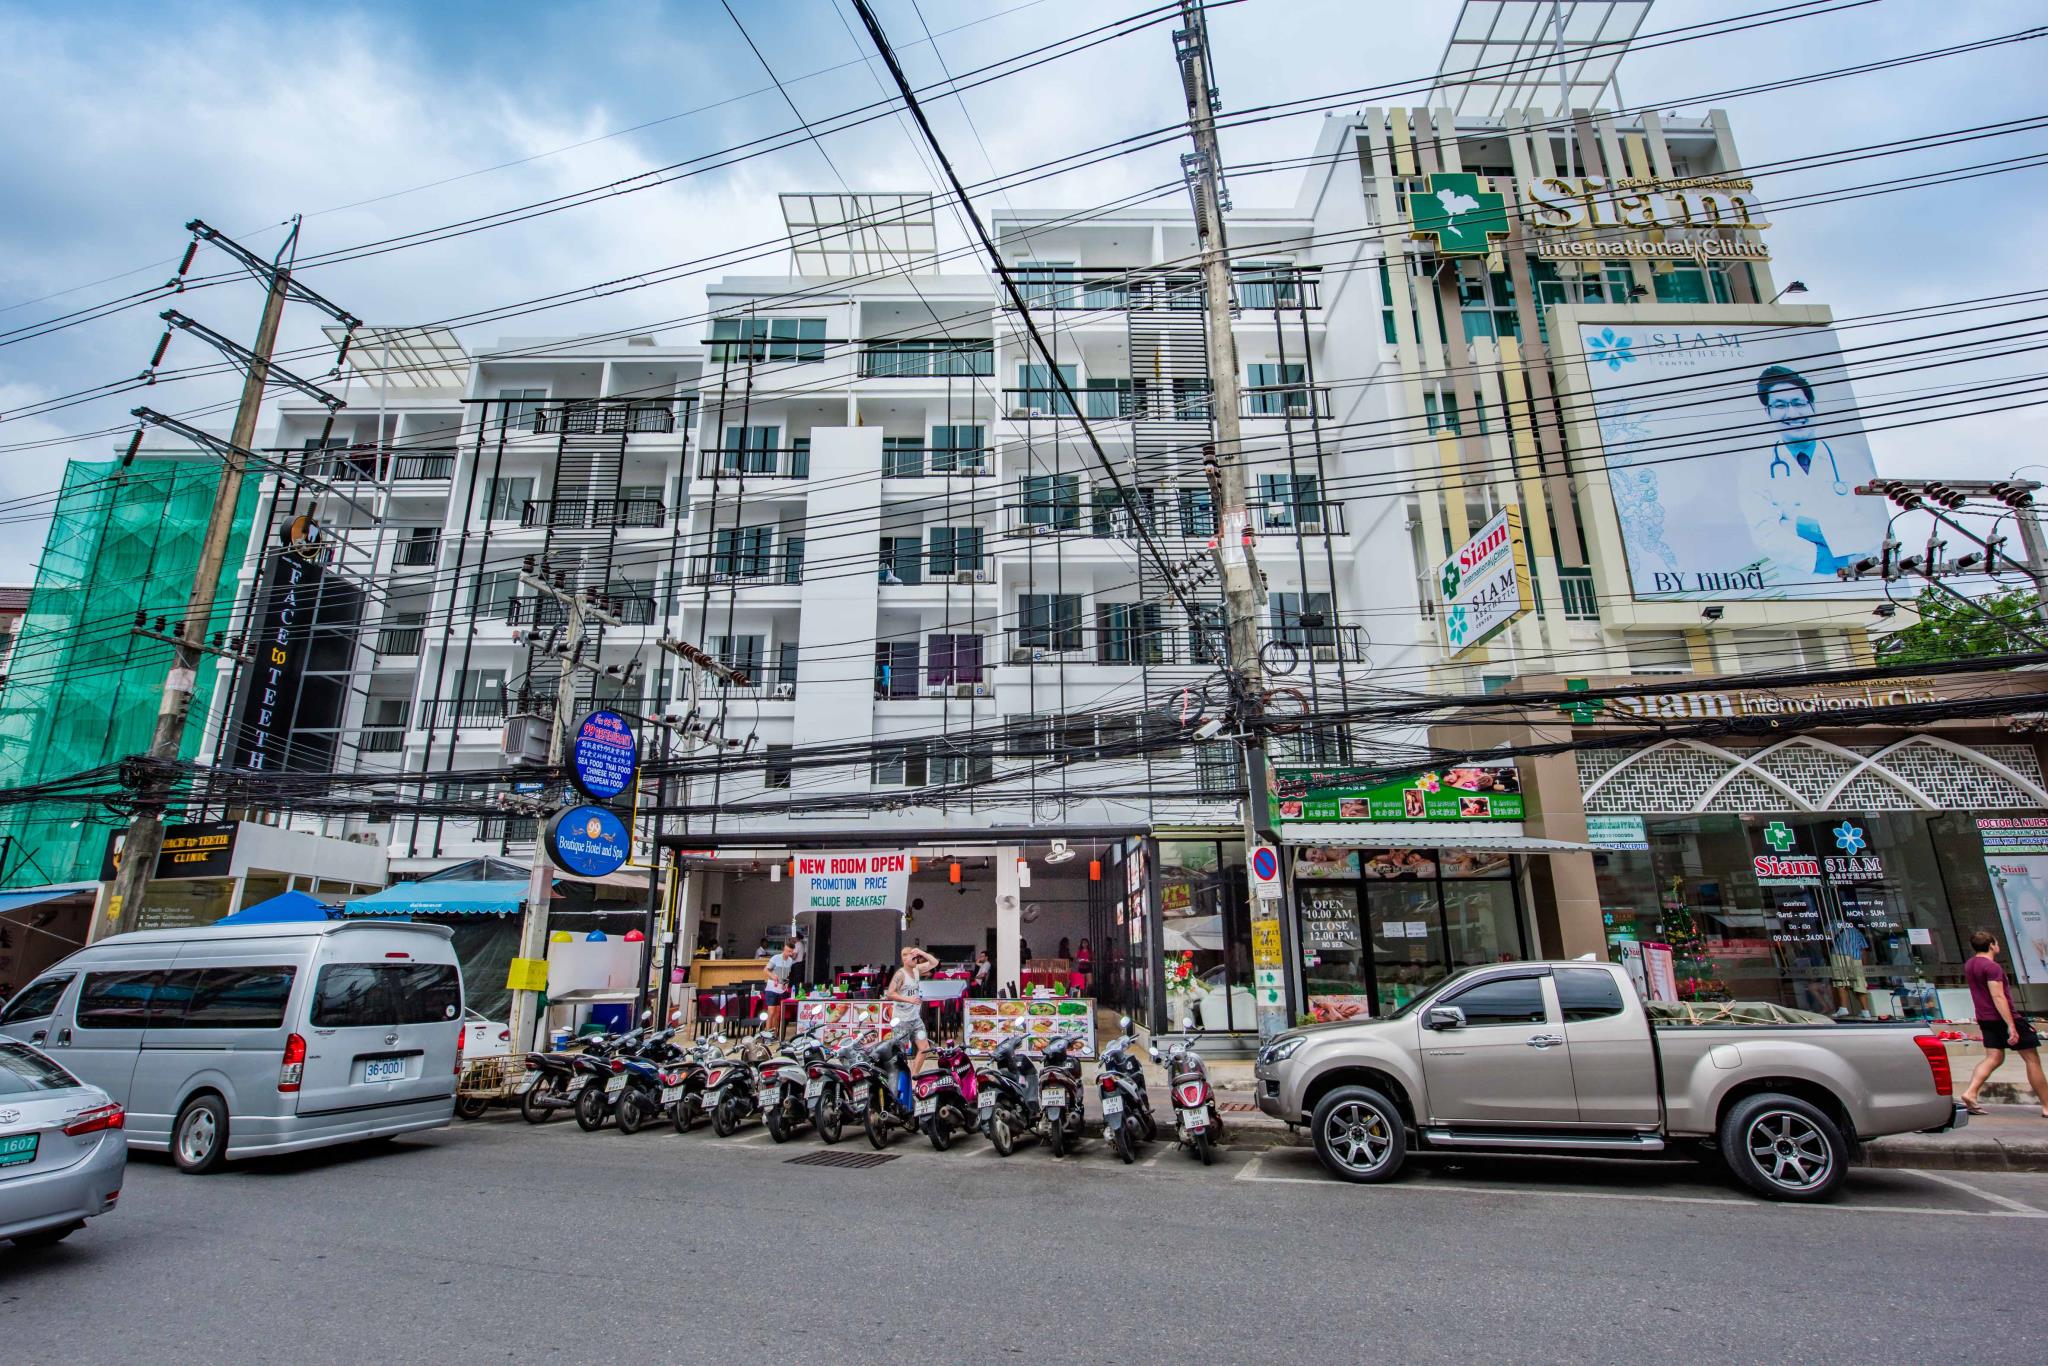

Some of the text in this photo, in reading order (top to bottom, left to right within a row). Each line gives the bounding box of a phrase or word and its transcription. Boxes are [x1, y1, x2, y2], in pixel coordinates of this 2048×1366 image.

[1528, 175, 1772, 229] Siam
[1538, 238, 1769, 255] International Clinic
[1652, 333, 1742, 348] SIAM
[1657, 350, 1744, 358] AESTHETIC
[1460, 524, 1507, 576] Siam
[1463, 545, 1510, 586] International Clinic
[1653, 572, 1685, 592] BY
[1472, 568, 1514, 613] SIAM
[248, 568, 302, 769] FACE to TEETH
[1613, 685, 1734, 718] Siam
[1739, 688, 1873, 714] International
[584, 723, 595, 736] 99
[595, 727, 631, 746] RESTAURANT
[578, 757, 588, 765] SEA
[590, 760, 604, 768] FOOD
[605, 763, 617, 771] THAI
[618, 766, 631, 774] FOOD
[583, 774, 623, 788] EUROPEAN FOOD
[586, 767, 622, 780] CHINESE FOOD
[590, 822, 600, 833] 99
[1976, 819, 2012, 828] DOCTOR
[2013, 818, 2021, 827] &
[187, 838, 198, 847] to
[199, 835, 229, 846] TEETH
[559, 836, 624, 861] Boutique Hotel and Spa
[174, 852, 210, 863] CLINIC
[799, 855, 904, 874] NEW ROOM OPEN
[1825, 857, 1882, 872] SIAM
[1754, 856, 1820, 876] Siam
[2001, 864, 2028, 873] Siam
[811, 877, 887, 890] PROMOTION PRICE
[811, 895, 887, 907] INCLUDE BREAKFAST
[1313, 900, 1344, 909] OPEN
[1306, 910, 1356, 918] 10.00 AM.
[1311, 921, 1349, 930] CLOSE
[1310, 931, 1358, 941] 12.00 PM.
[367, 1062, 404, 1076] 36-0001
[4, 1137, 34, 1152] 1607
